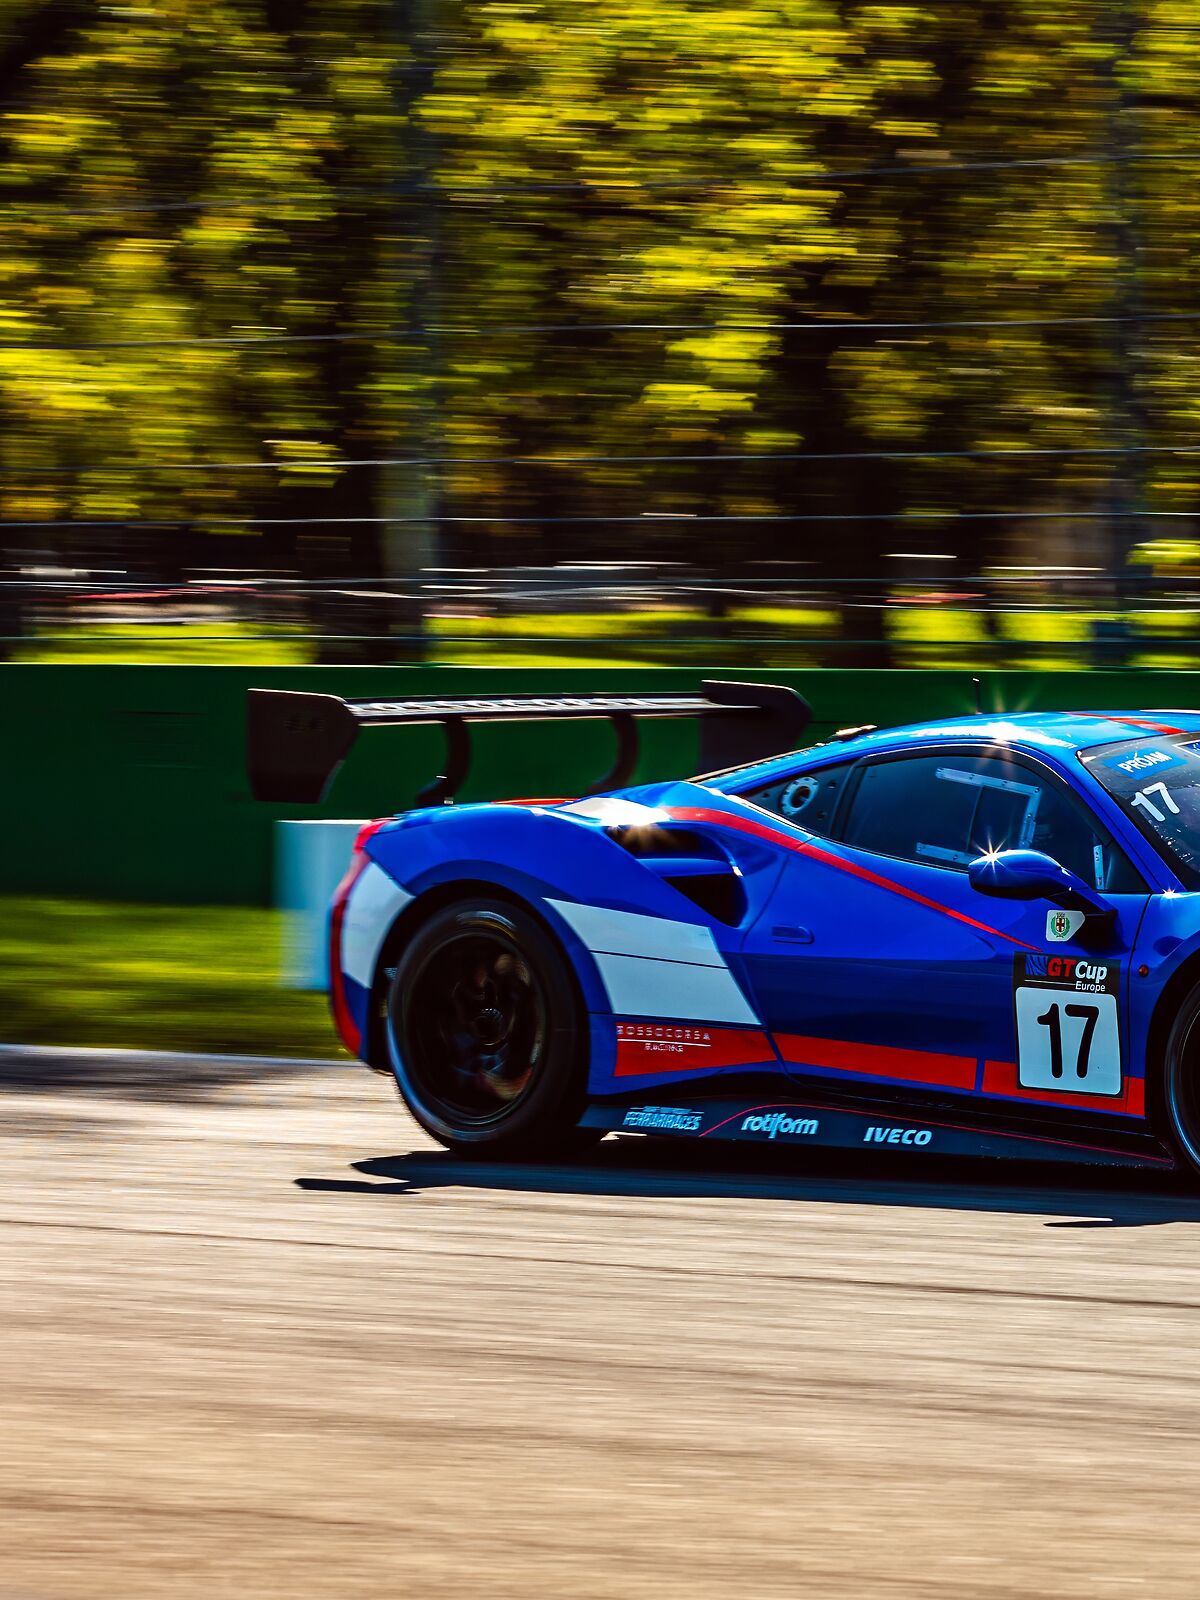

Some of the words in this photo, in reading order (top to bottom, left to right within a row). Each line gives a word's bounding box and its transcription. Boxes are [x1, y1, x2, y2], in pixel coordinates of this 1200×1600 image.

[1131, 781, 1181, 822] 17
[1047, 957, 1076, 977] GT
[1075, 960, 1108, 984] Cup
[1075, 980, 1106, 994] Europe
[1036, 1002, 1100, 1079] 17
[741, 1112, 819, 1139] rotiform
[862, 1126, 933, 1146] IVECO
